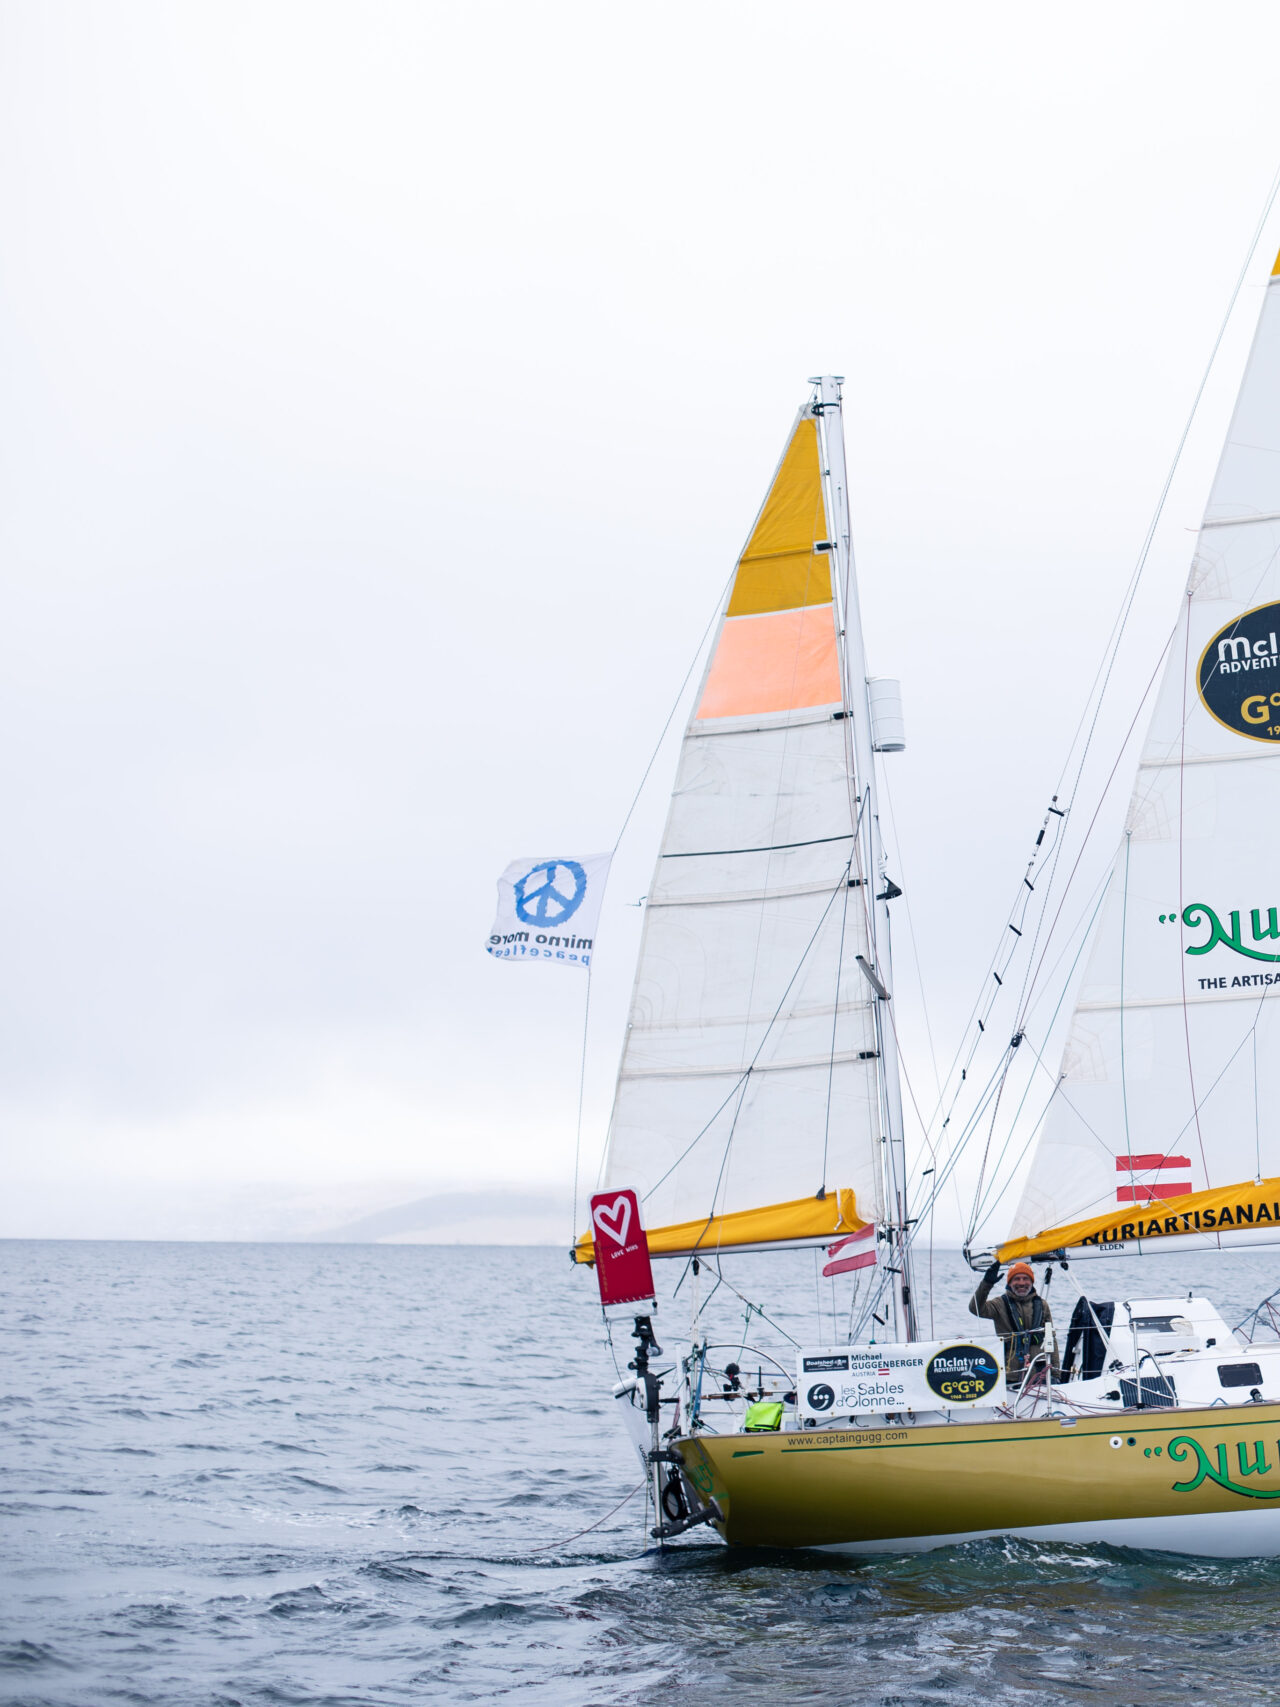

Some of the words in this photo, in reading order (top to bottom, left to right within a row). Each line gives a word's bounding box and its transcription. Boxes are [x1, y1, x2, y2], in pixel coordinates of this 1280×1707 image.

[1198, 976, 1228, 990] THE
[851, 1353, 882, 1361] Michael
[933, 1357, 986, 1368] McIntyre
[851, 1359, 923, 1370] GUGGENBERGER
[934, 1365, 968, 1373] ADVENTURE
[841, 1384, 856, 1396] les
[857, 1381, 905, 1396] Sables
[787, 1431, 908, 1446] www.captaingugg.com
